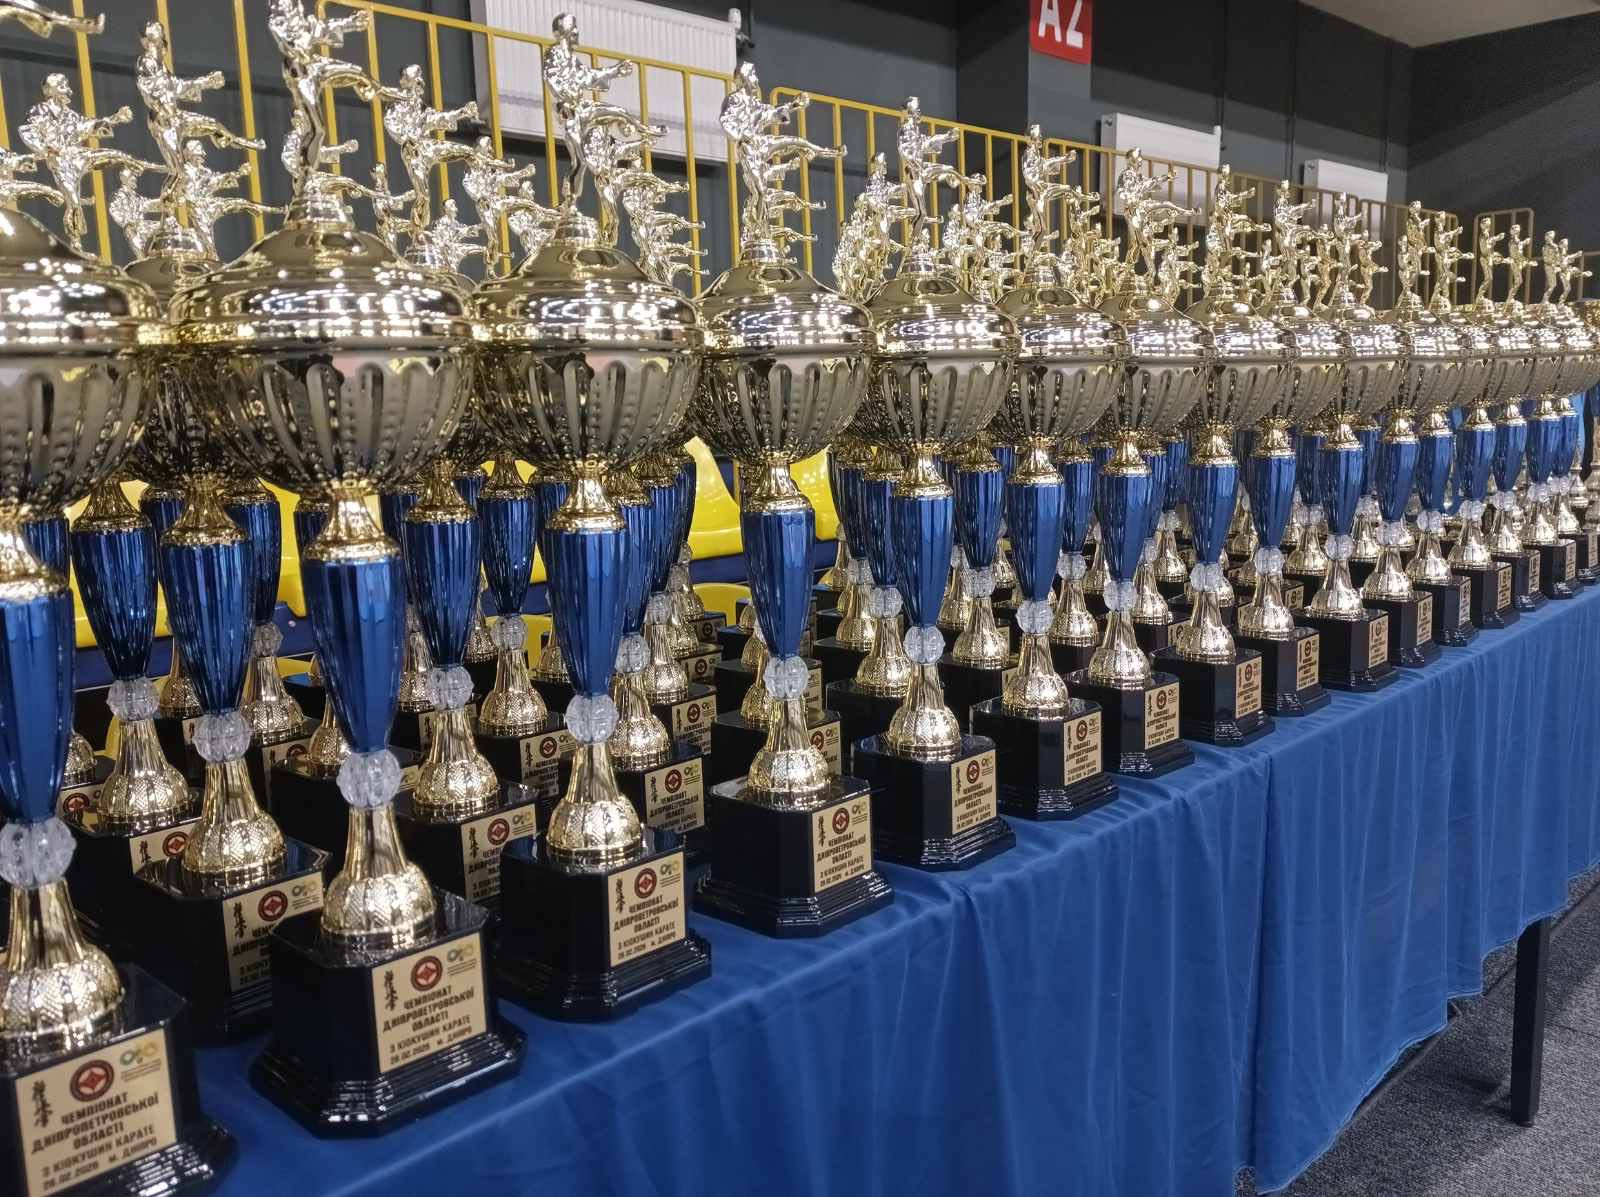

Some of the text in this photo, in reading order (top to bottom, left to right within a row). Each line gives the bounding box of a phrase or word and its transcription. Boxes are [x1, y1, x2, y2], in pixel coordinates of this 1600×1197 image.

[382, 987, 474, 1031] ДНІПРОПЕТРОВСЬКОЇ
[403, 985, 451, 1010] ЧЕМПІОНАТ
[411, 1009, 448, 1031] ОБЛАСТІ
[30, 1092, 159, 1152] ДНІПРОПЕТРОВСЬКОЇ
[61, 1091, 128, 1126] ЧЕМПІОНАТ
[73, 1120, 124, 1149] ОБЛАСТІ
[115, 1123, 154, 1147] КАРАТЕ
